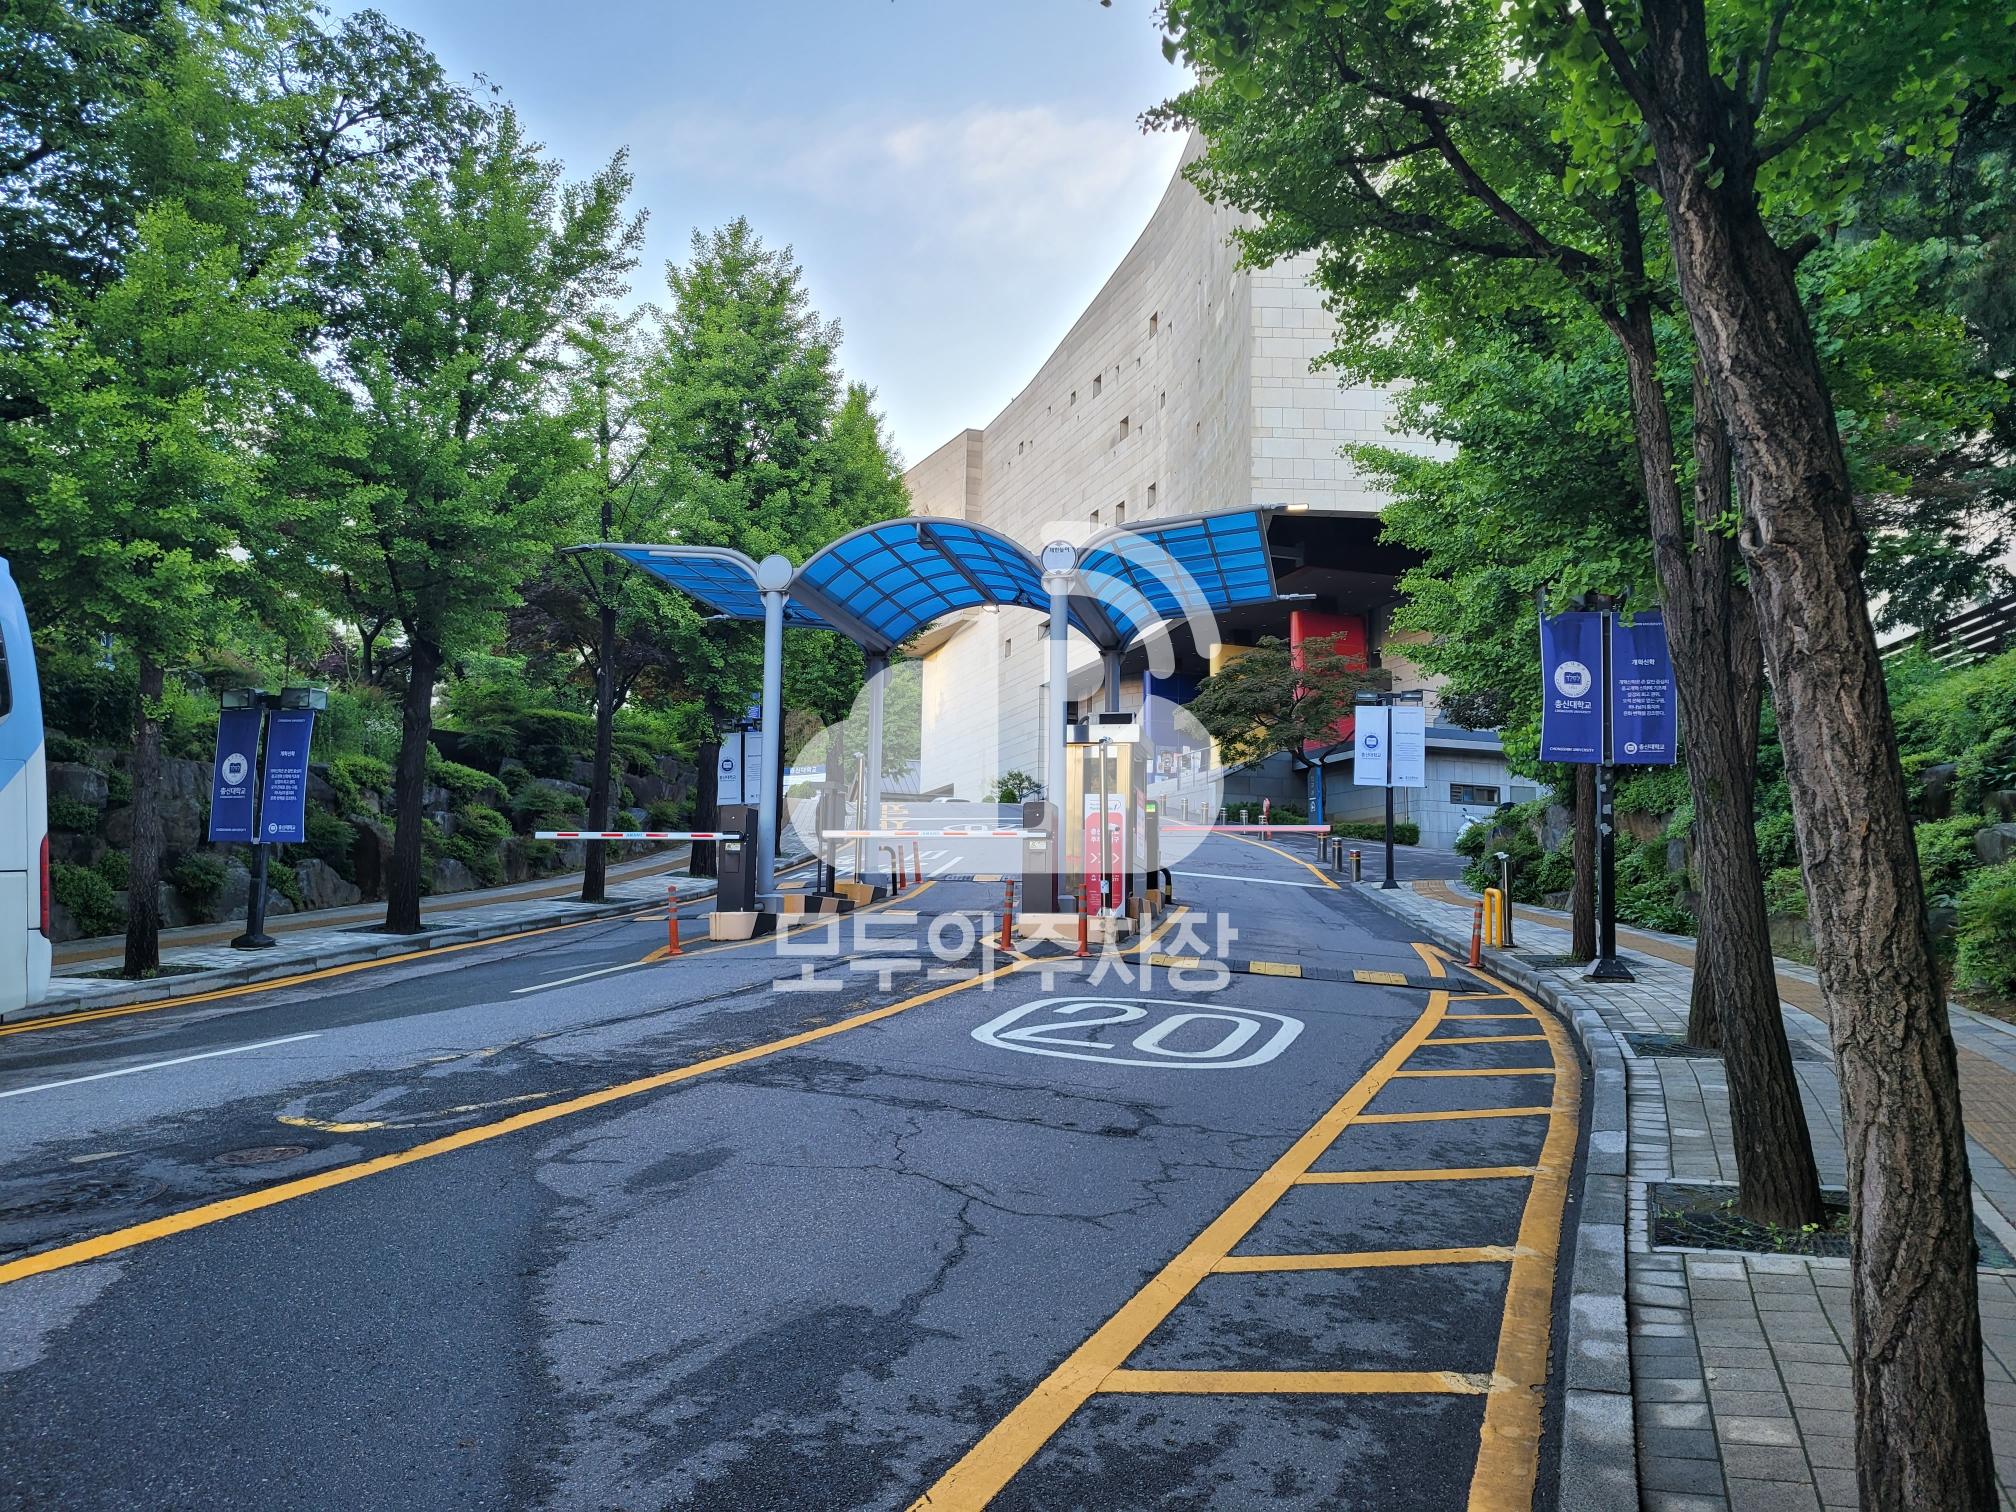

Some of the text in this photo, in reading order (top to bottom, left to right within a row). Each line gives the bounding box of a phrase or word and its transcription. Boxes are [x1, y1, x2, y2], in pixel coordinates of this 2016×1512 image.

[1631, 658, 1655, 666] 개혁신학
[1554, 699, 1592, 709] 총신대학교
[996, 1002, 1262, 1058] 20
